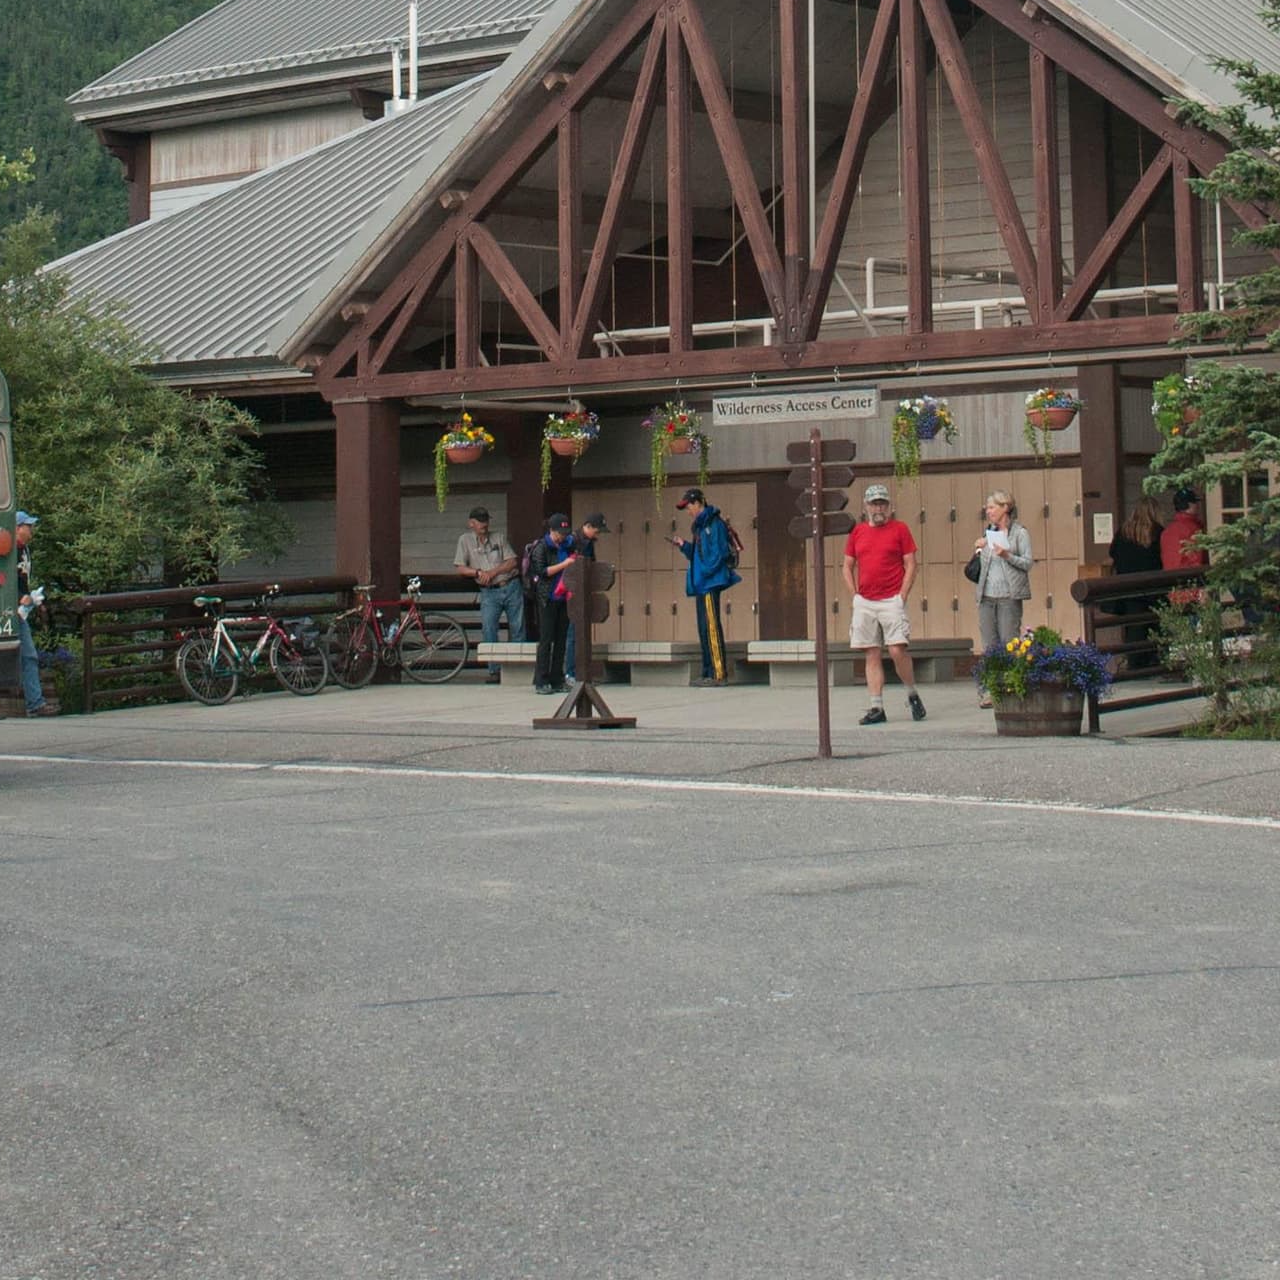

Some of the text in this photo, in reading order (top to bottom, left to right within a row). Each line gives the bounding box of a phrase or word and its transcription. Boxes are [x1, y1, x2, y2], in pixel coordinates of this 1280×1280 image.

[716, 396, 873, 416] Wilderness Access Center
